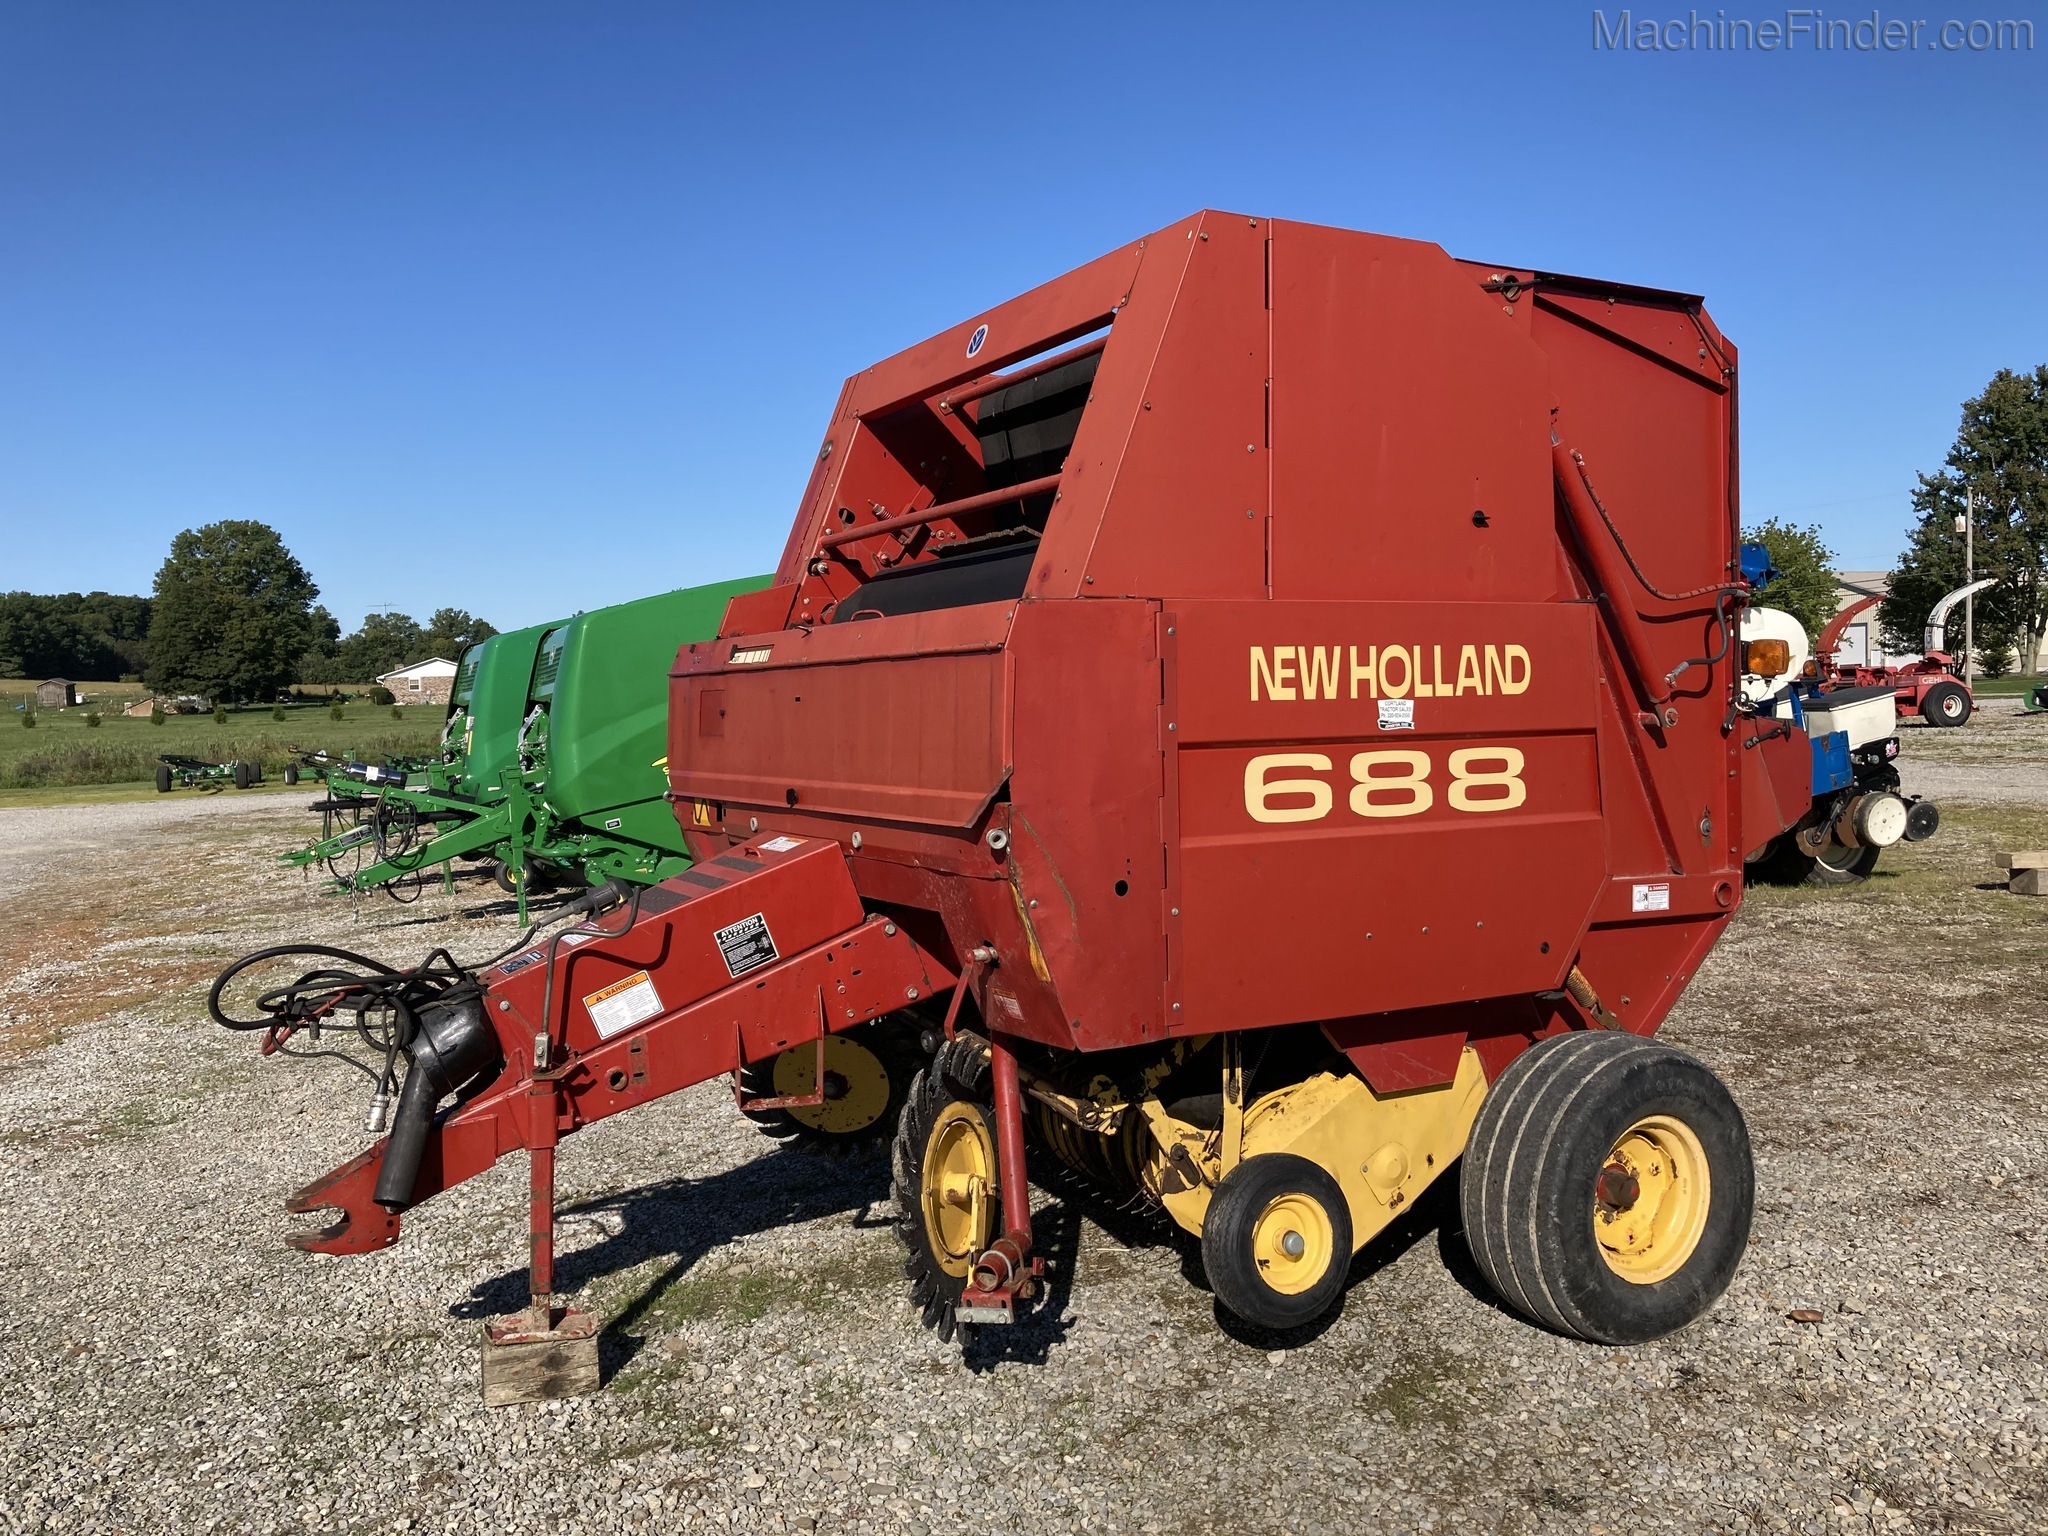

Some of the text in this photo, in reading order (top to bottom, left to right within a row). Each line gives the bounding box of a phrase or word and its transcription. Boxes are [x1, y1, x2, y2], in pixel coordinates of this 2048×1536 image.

[1250, 644, 1531, 701] NEW HOLLAND
[1922, 676, 1943, 685] GEHL
[1243, 747, 1527, 823] 688
[721, 917, 758, 938] ATTENTION
[604, 978, 638, 997] WARNING
